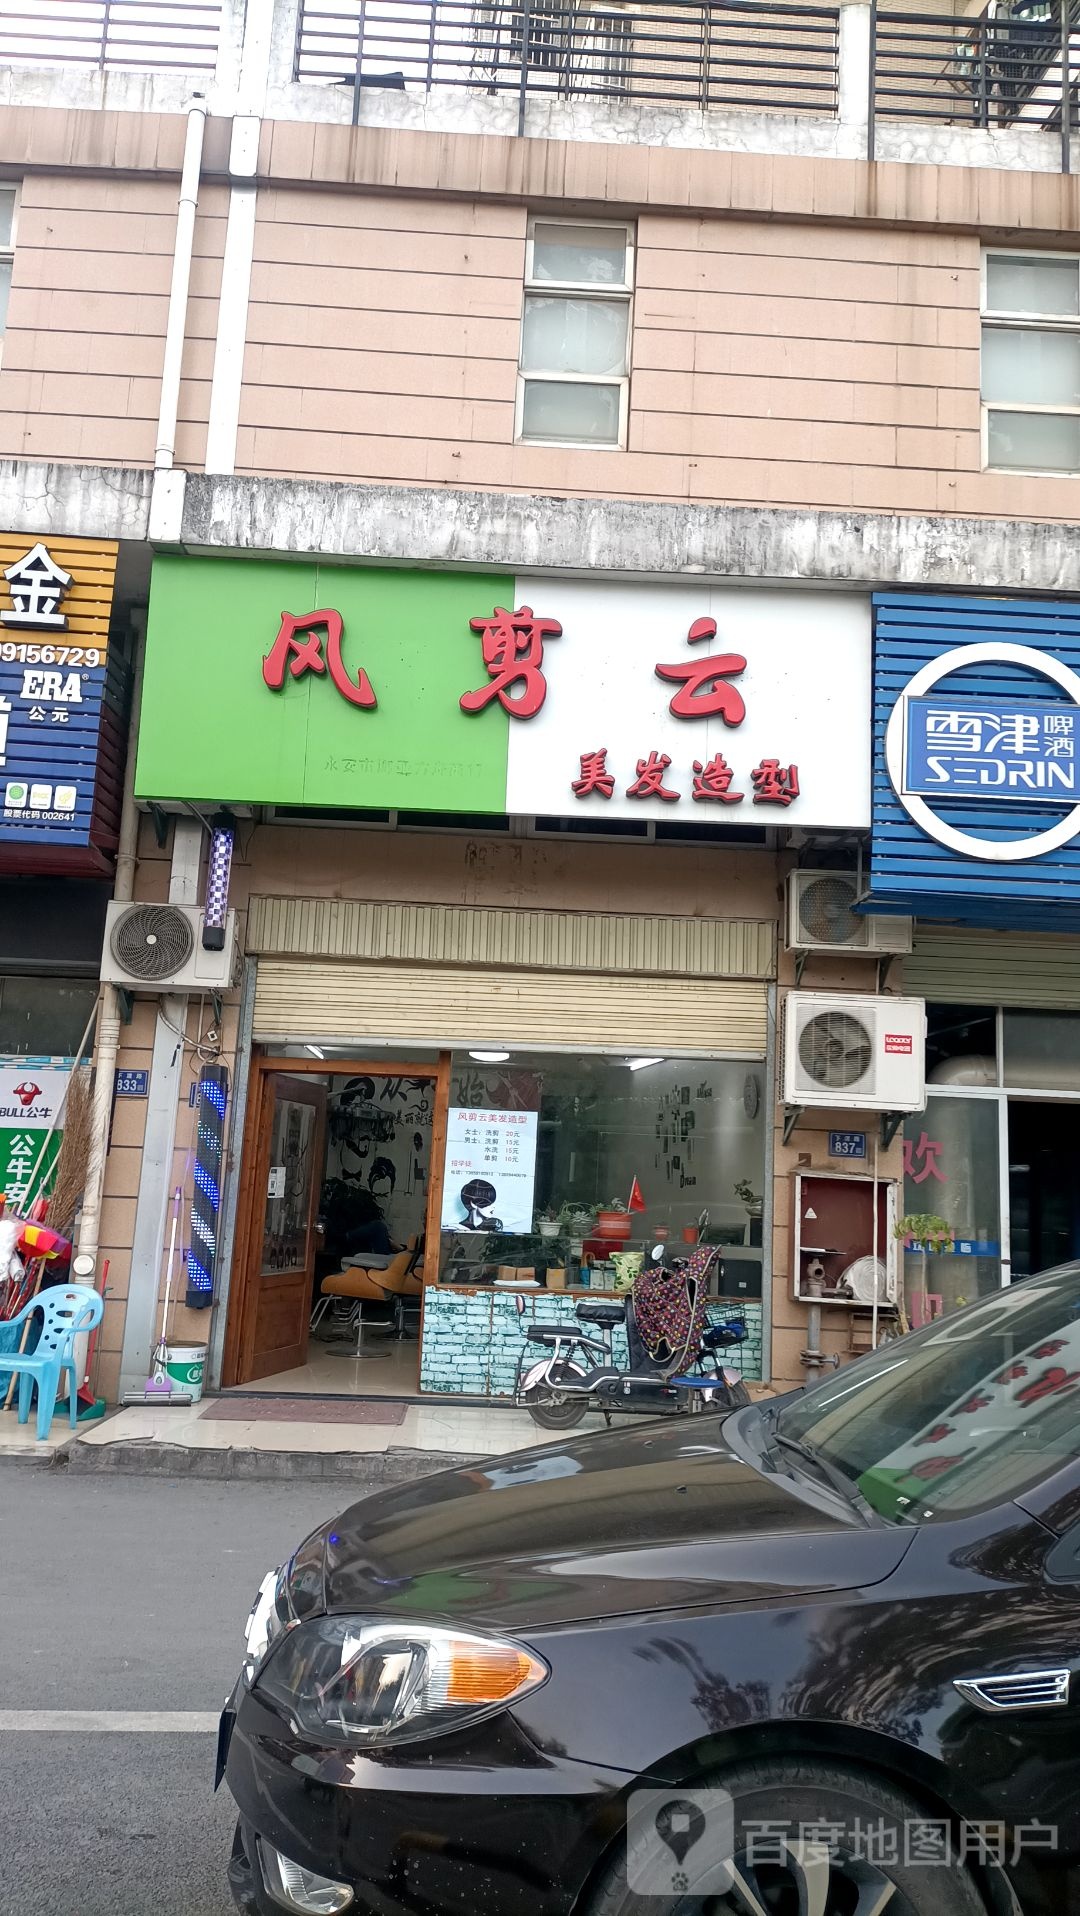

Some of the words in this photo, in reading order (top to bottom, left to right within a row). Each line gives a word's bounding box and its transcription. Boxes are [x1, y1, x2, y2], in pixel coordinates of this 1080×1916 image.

[0, 542, 73, 627] 金
[0, 642, 100, 668] 9156729
[261, 604, 749, 729] 风剪云
[20, 669, 83, 703] ERA
[28, 705, 69, 723] 公元
[925, 709, 1040, 755] 雪津
[1043, 715, 1075, 758] 啤酒
[569, 746, 800, 807] 美发造型
[924, 756, 1075, 789] SEDRIN
[3, 808, 41, 820] 股票代码
[41, 811, 75, 822] 002641
[117, 1079, 137, 1091] 833
[457, 1112, 528, 1124] 风剪云美发造型
[835, 1141, 856, 1154] 837
